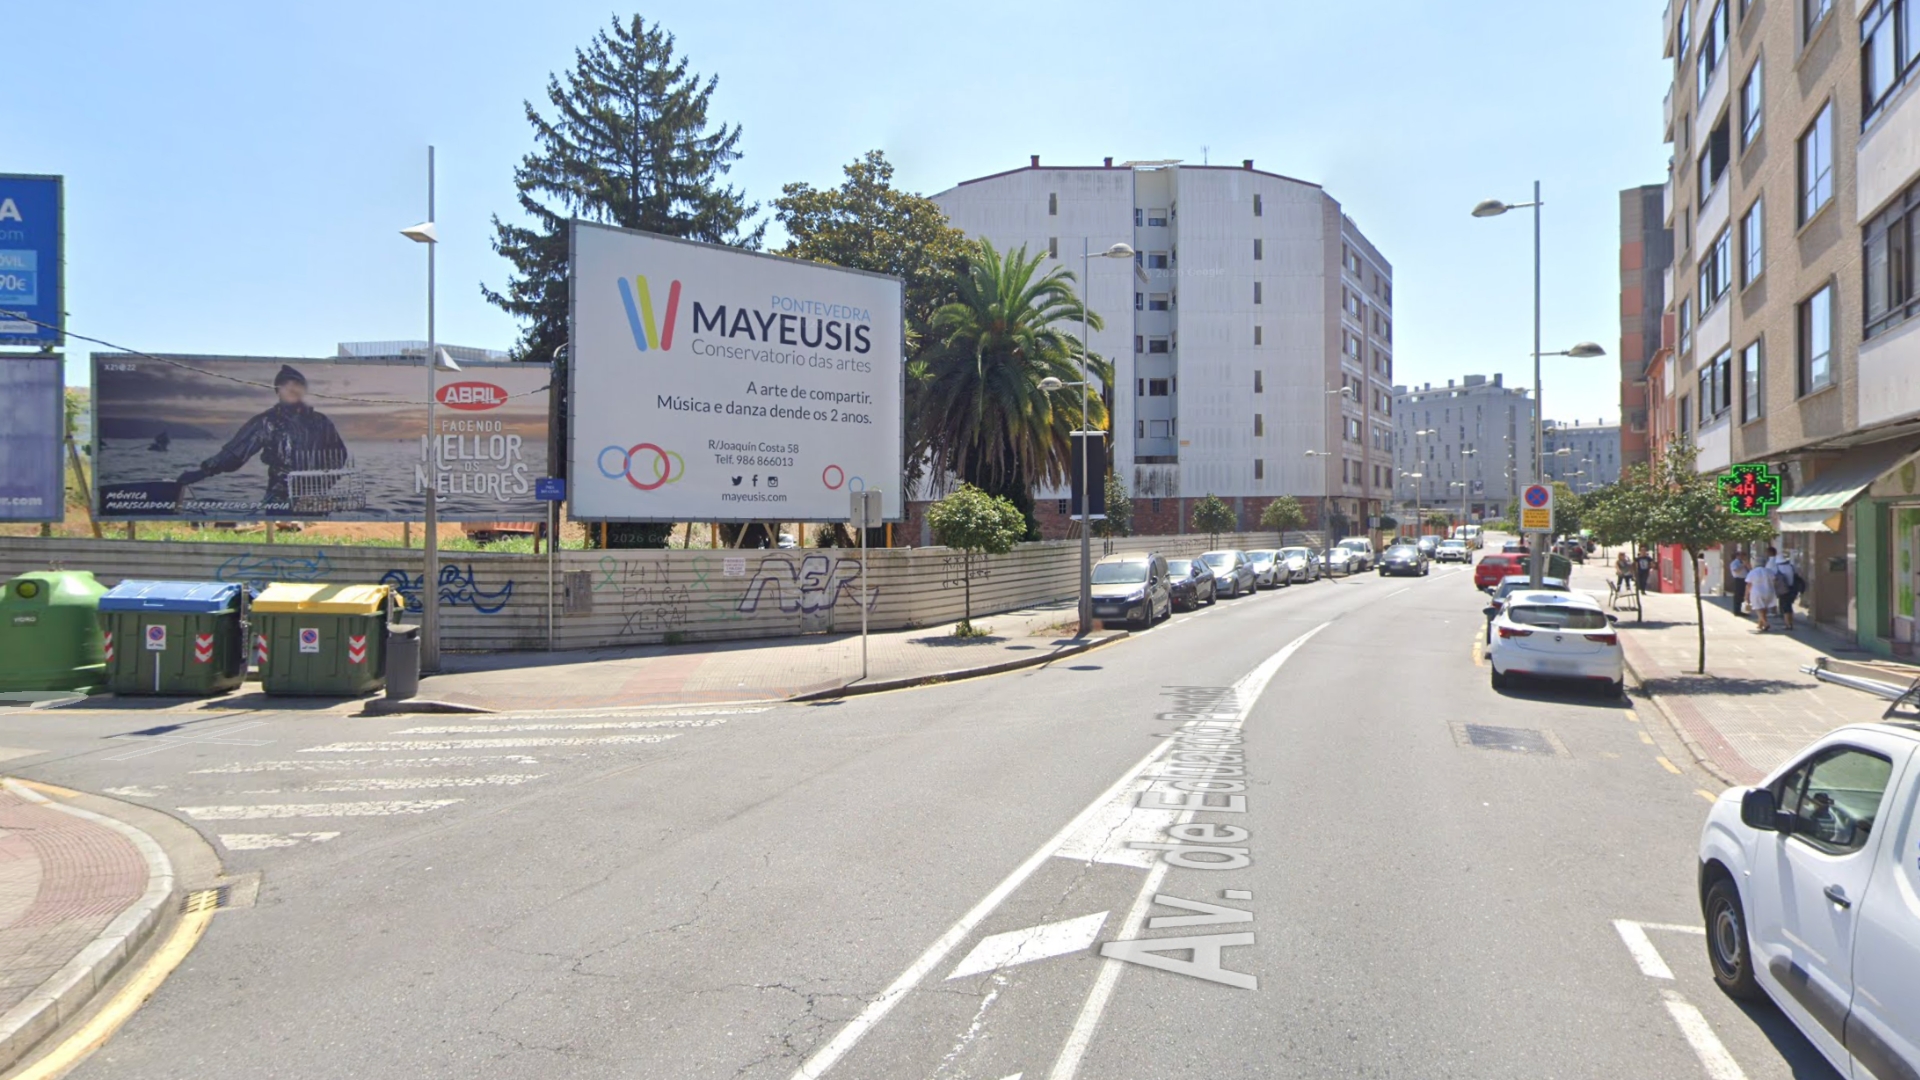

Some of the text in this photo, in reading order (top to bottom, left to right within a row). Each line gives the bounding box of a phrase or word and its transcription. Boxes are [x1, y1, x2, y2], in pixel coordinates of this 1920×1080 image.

[0, 198, 22, 222] A
[771, 295, 871, 322] PONTEVEDRA
[692, 301, 871, 354] MAYEUSIS
[691, 338, 871, 373] Conservatorio das artes
[444, 387, 500, 404] ABRIL
[746, 381, 873, 404] A arte de compartir.
[657, 394, 873, 424] Música e danza dende os 2 anos.
[442, 420, 502, 432] FACENDO
[421, 434, 522, 470] MELLOR
[708, 439, 799, 454] R/Joaquín Costa 58
[464, 461, 480, 471] OS
[714, 453, 794, 467] Telf. 986 866013
[415, 463, 529, 502] MELLORES
[0, 497, 43, 506] r.com
[106, 490, 147, 499] MÓNICA
[106, 501, 176, 510] MARISCADORA
[186, 502, 247, 510] BERBERECHO
[265, 502, 290, 510] NOIA
[721, 491, 787, 503] mayeusis.com
[621, 584, 691, 612] FOLGA
[619, 606, 694, 636] XERAL
